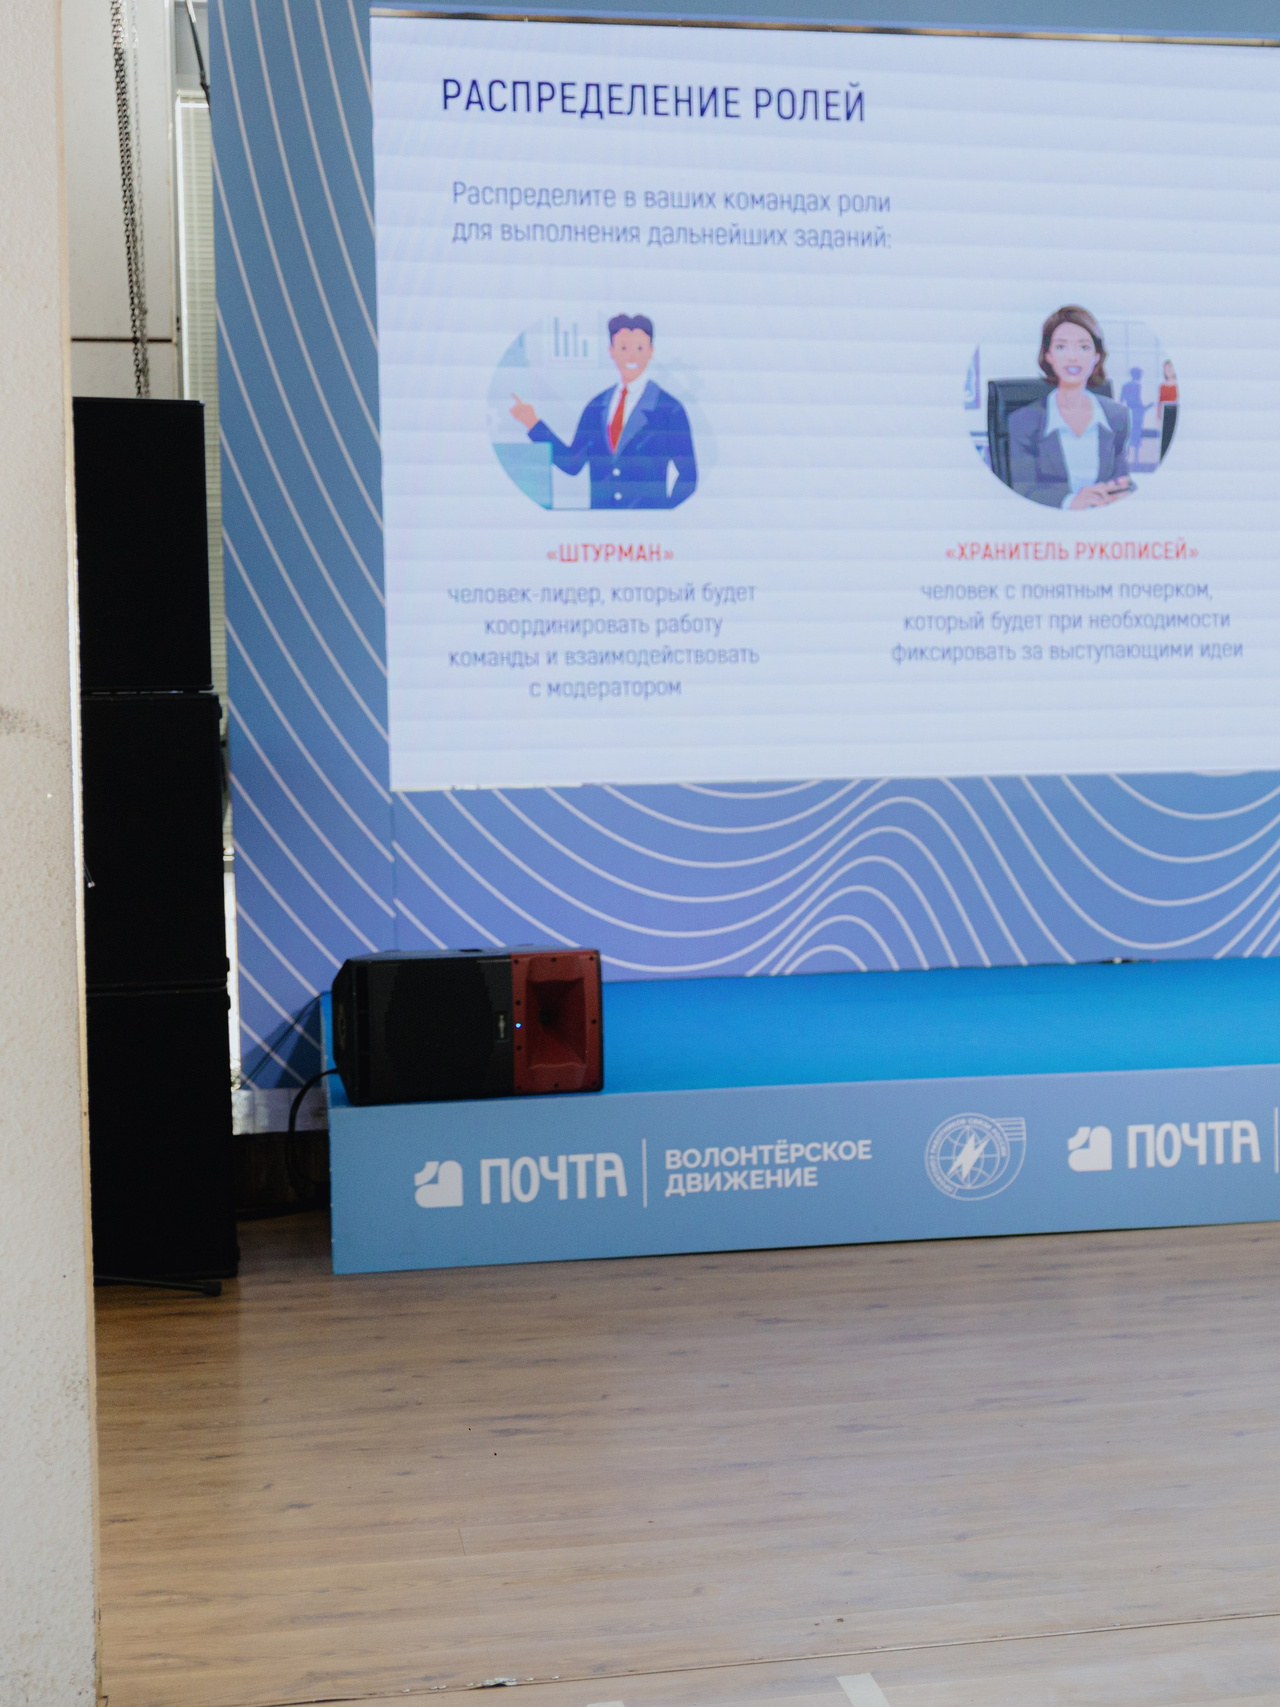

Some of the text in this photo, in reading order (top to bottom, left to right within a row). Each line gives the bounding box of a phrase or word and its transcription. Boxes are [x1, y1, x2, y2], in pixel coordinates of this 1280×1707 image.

[442, 78, 866, 121] РАСПРЕДЕЛЕНИЕ РОЛЕЙ
[452, 180, 891, 216] Распределите в ваших командах роли
[452, 220, 892, 250] для выполнения дальнейших заданий:
[546, 543, 675, 563] «ШТУРМАН»
[945, 536, 1200, 561] «ХРАНИТЕЛЬ РУКОПИСЕЙ»
[447, 581, 757, 607] человек-лидер, который будет
[921, 581, 1214, 603] человек с понятным почерком,
[484, 612, 723, 640] координировать работу
[903, 609, 1231, 635] который будет при необходимости
[449, 645, 760, 668] команды и взаимодействовать
[890, 640, 1244, 665] фиксировать за выступающими идеи
[528, 678, 682, 701] с модератором
[665, 1138, 873, 1171] ВОЛОНТЁРСКОЕ
[1127, 1119, 1261, 1169] ПОЧТА
[480, 1152, 628, 1205] ПОЧТА
[664, 1165, 819, 1198] ДВИЖЕНИЕ
